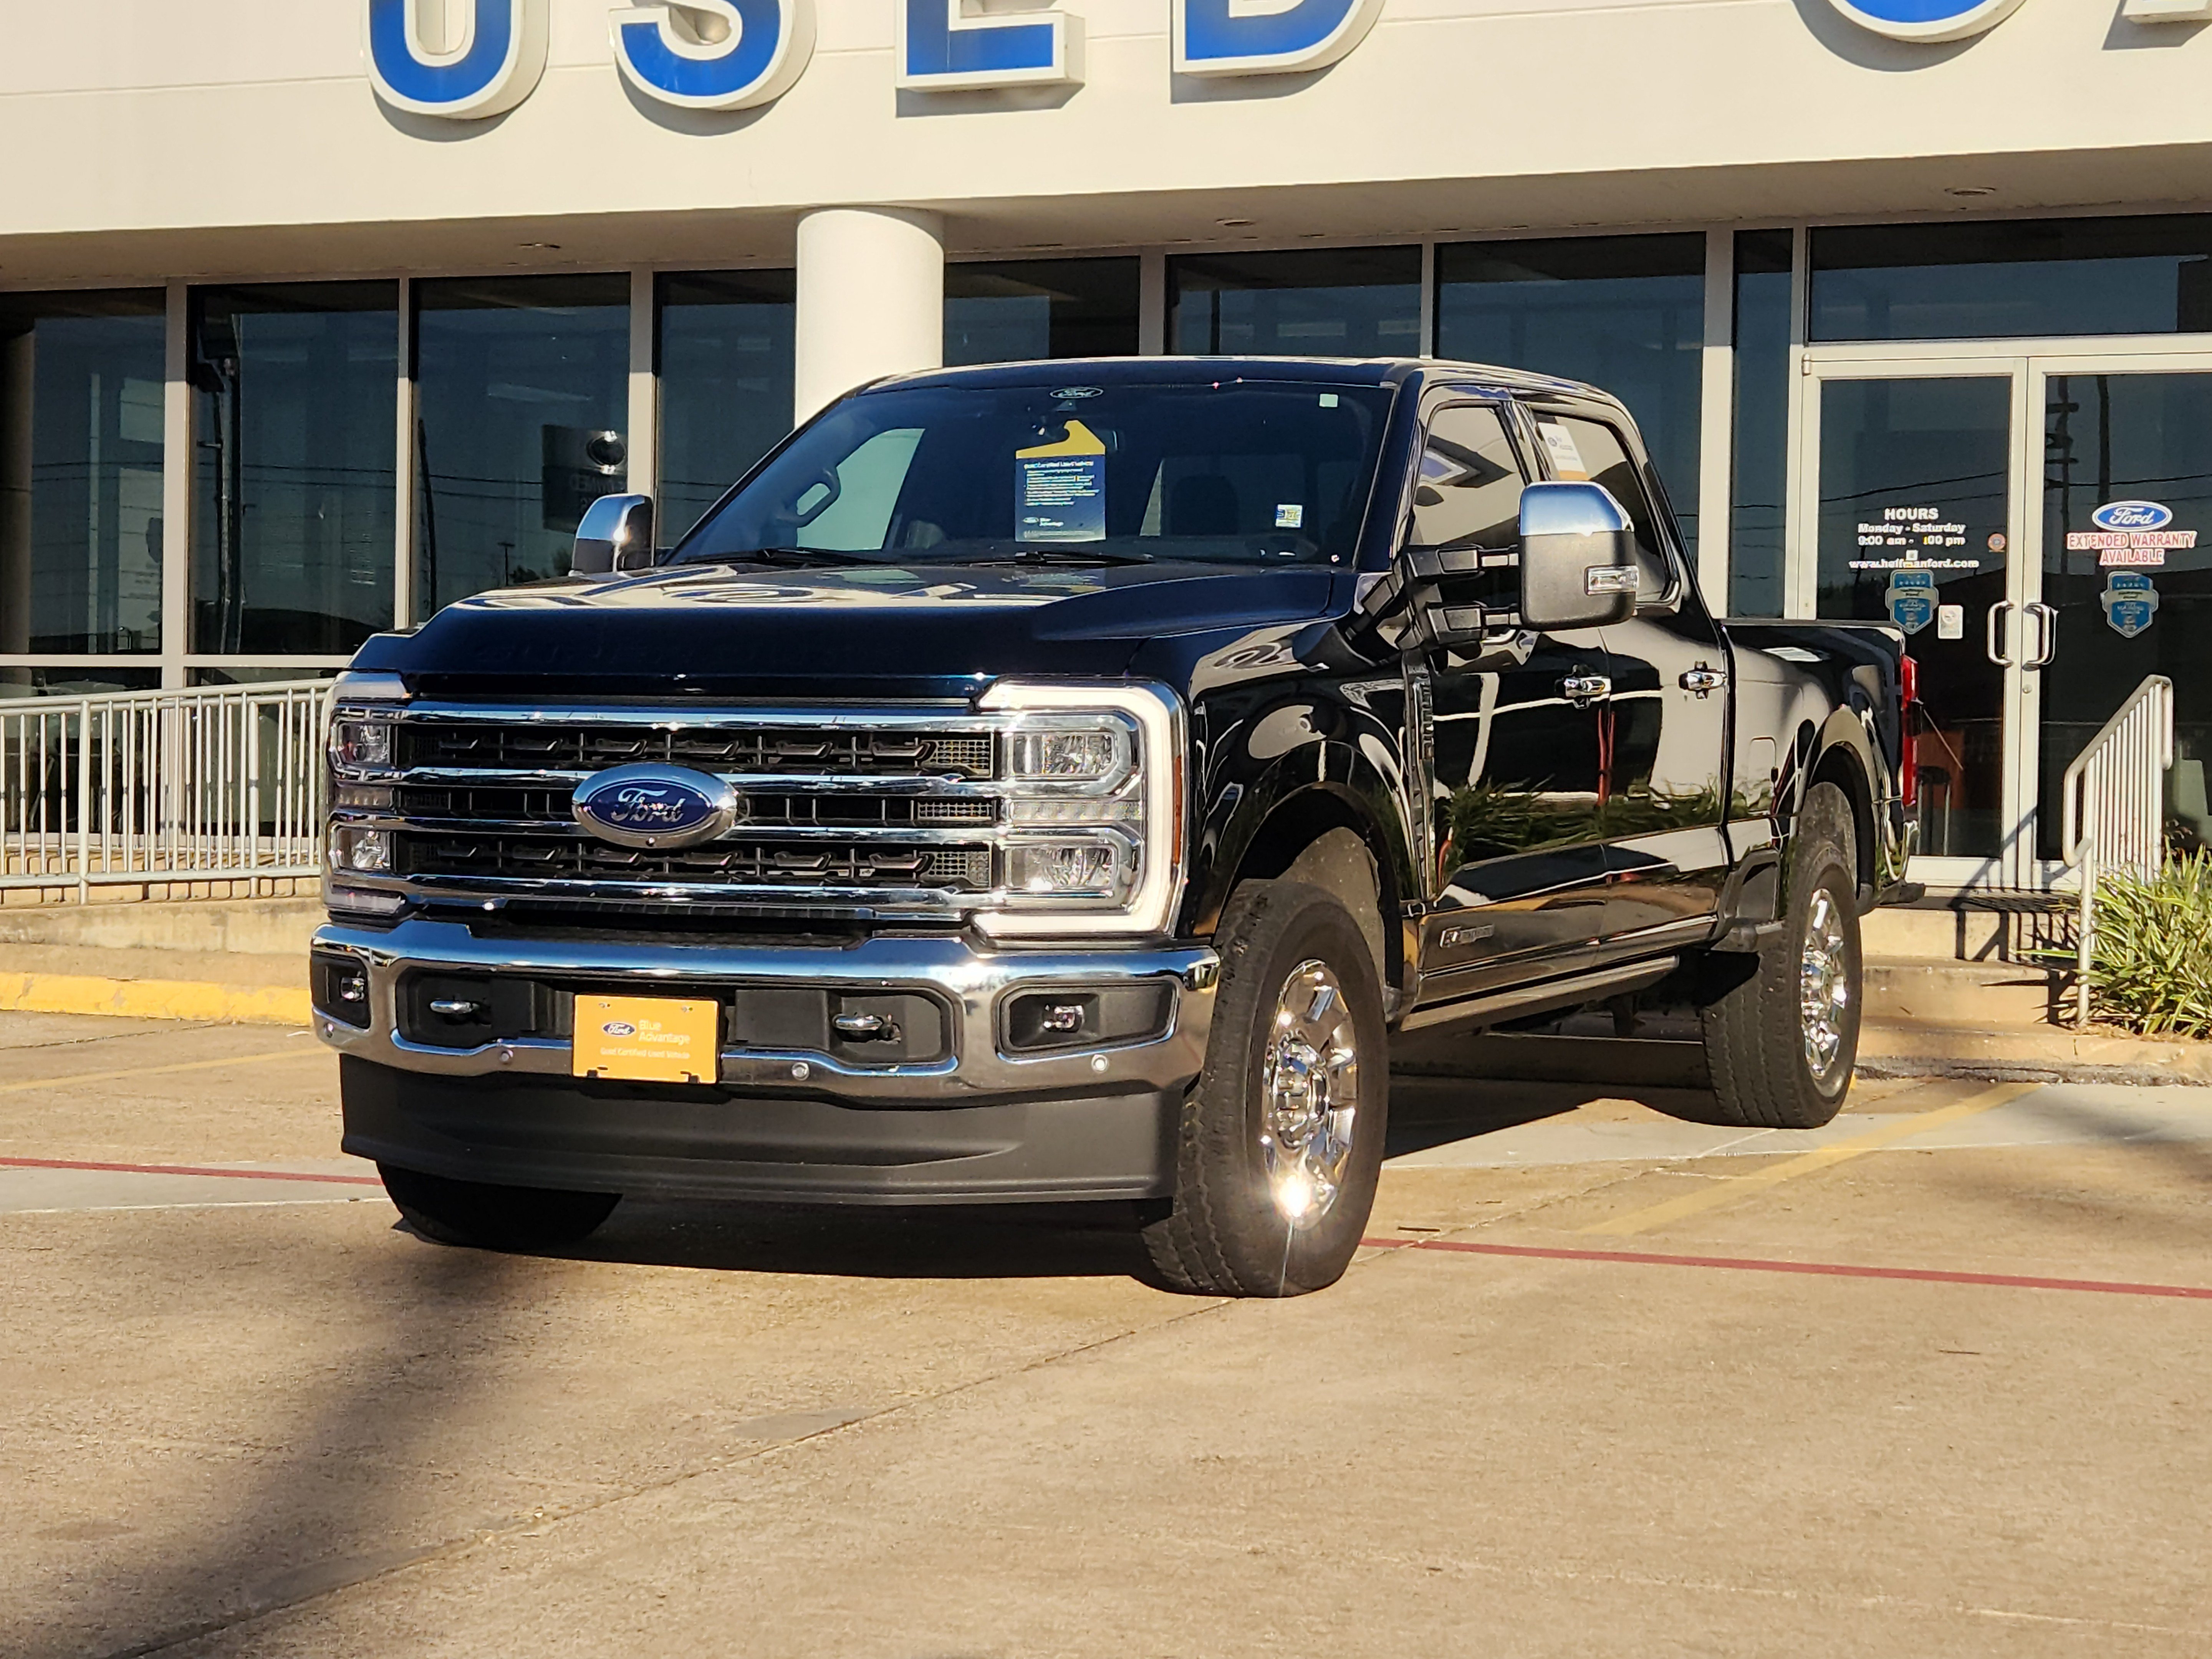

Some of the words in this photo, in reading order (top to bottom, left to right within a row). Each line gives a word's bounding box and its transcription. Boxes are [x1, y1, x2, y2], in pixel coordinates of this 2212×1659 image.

[1884, 508, 1939, 520] HOURS
[2109, 507, 2155, 524] Ford
[1858, 523, 1904, 534] Monday
[1912, 523, 1966, 534] Saturday
[1858, 535, 1883, 545] 9:00
[1886, 537, 1906, 545] am
[1945, 536, 1965, 547] pm
[2068, 533, 2128, 549] EXTENDED
[2130, 532, 2196, 548] WARRANTY
[2101, 549, 2164, 565] AVAILABLE
[610, 788, 686, 822] Ford
[638, 1019, 662, 1031] Blue
[638, 1031, 690, 1045] Advantage
